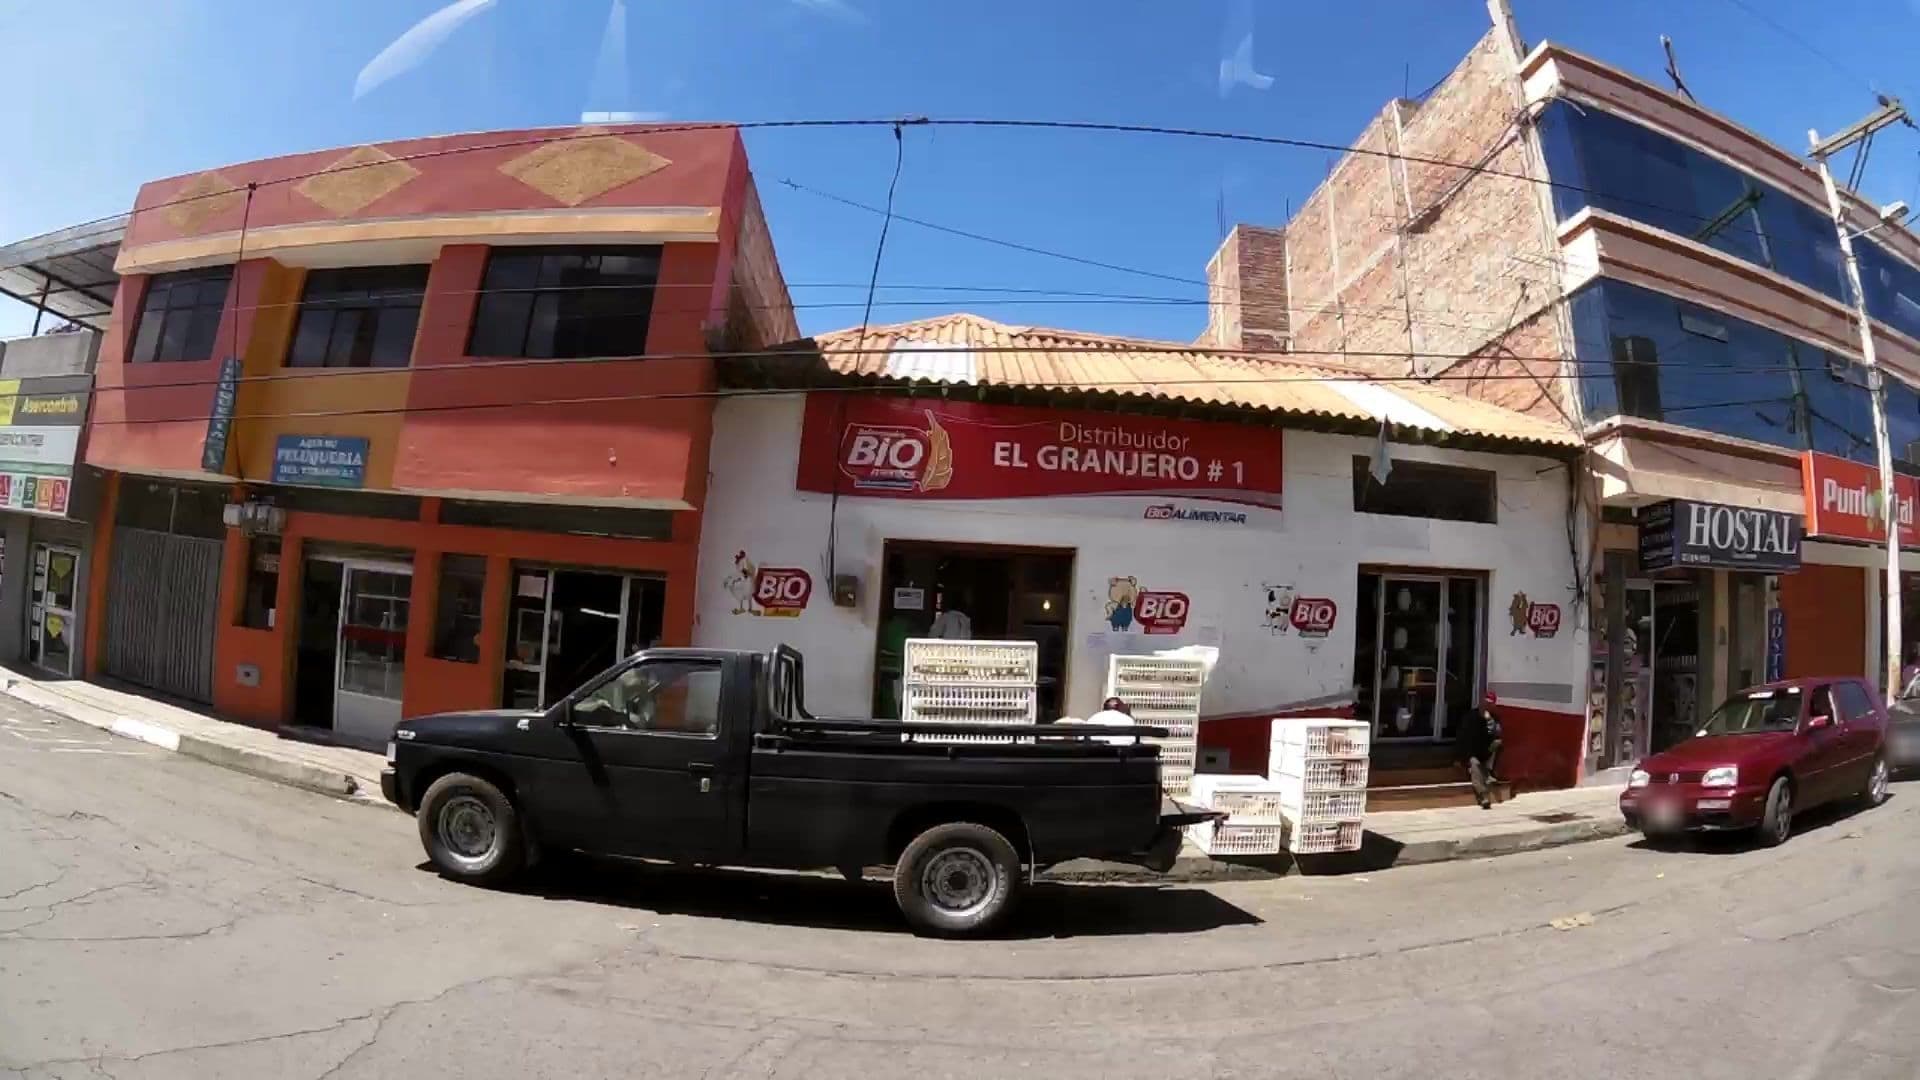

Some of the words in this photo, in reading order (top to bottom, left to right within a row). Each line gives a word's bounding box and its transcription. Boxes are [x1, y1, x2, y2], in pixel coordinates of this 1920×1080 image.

[1059, 422, 1190, 452] Distribuidor
[994, 441, 1028, 468] EL
[1036, 444, 1199, 480] GRANJERO
[1207, 459, 1223, 482] #
[1231, 461, 1244, 484] 1
[1686, 503, 1797, 554] HOSTAL
